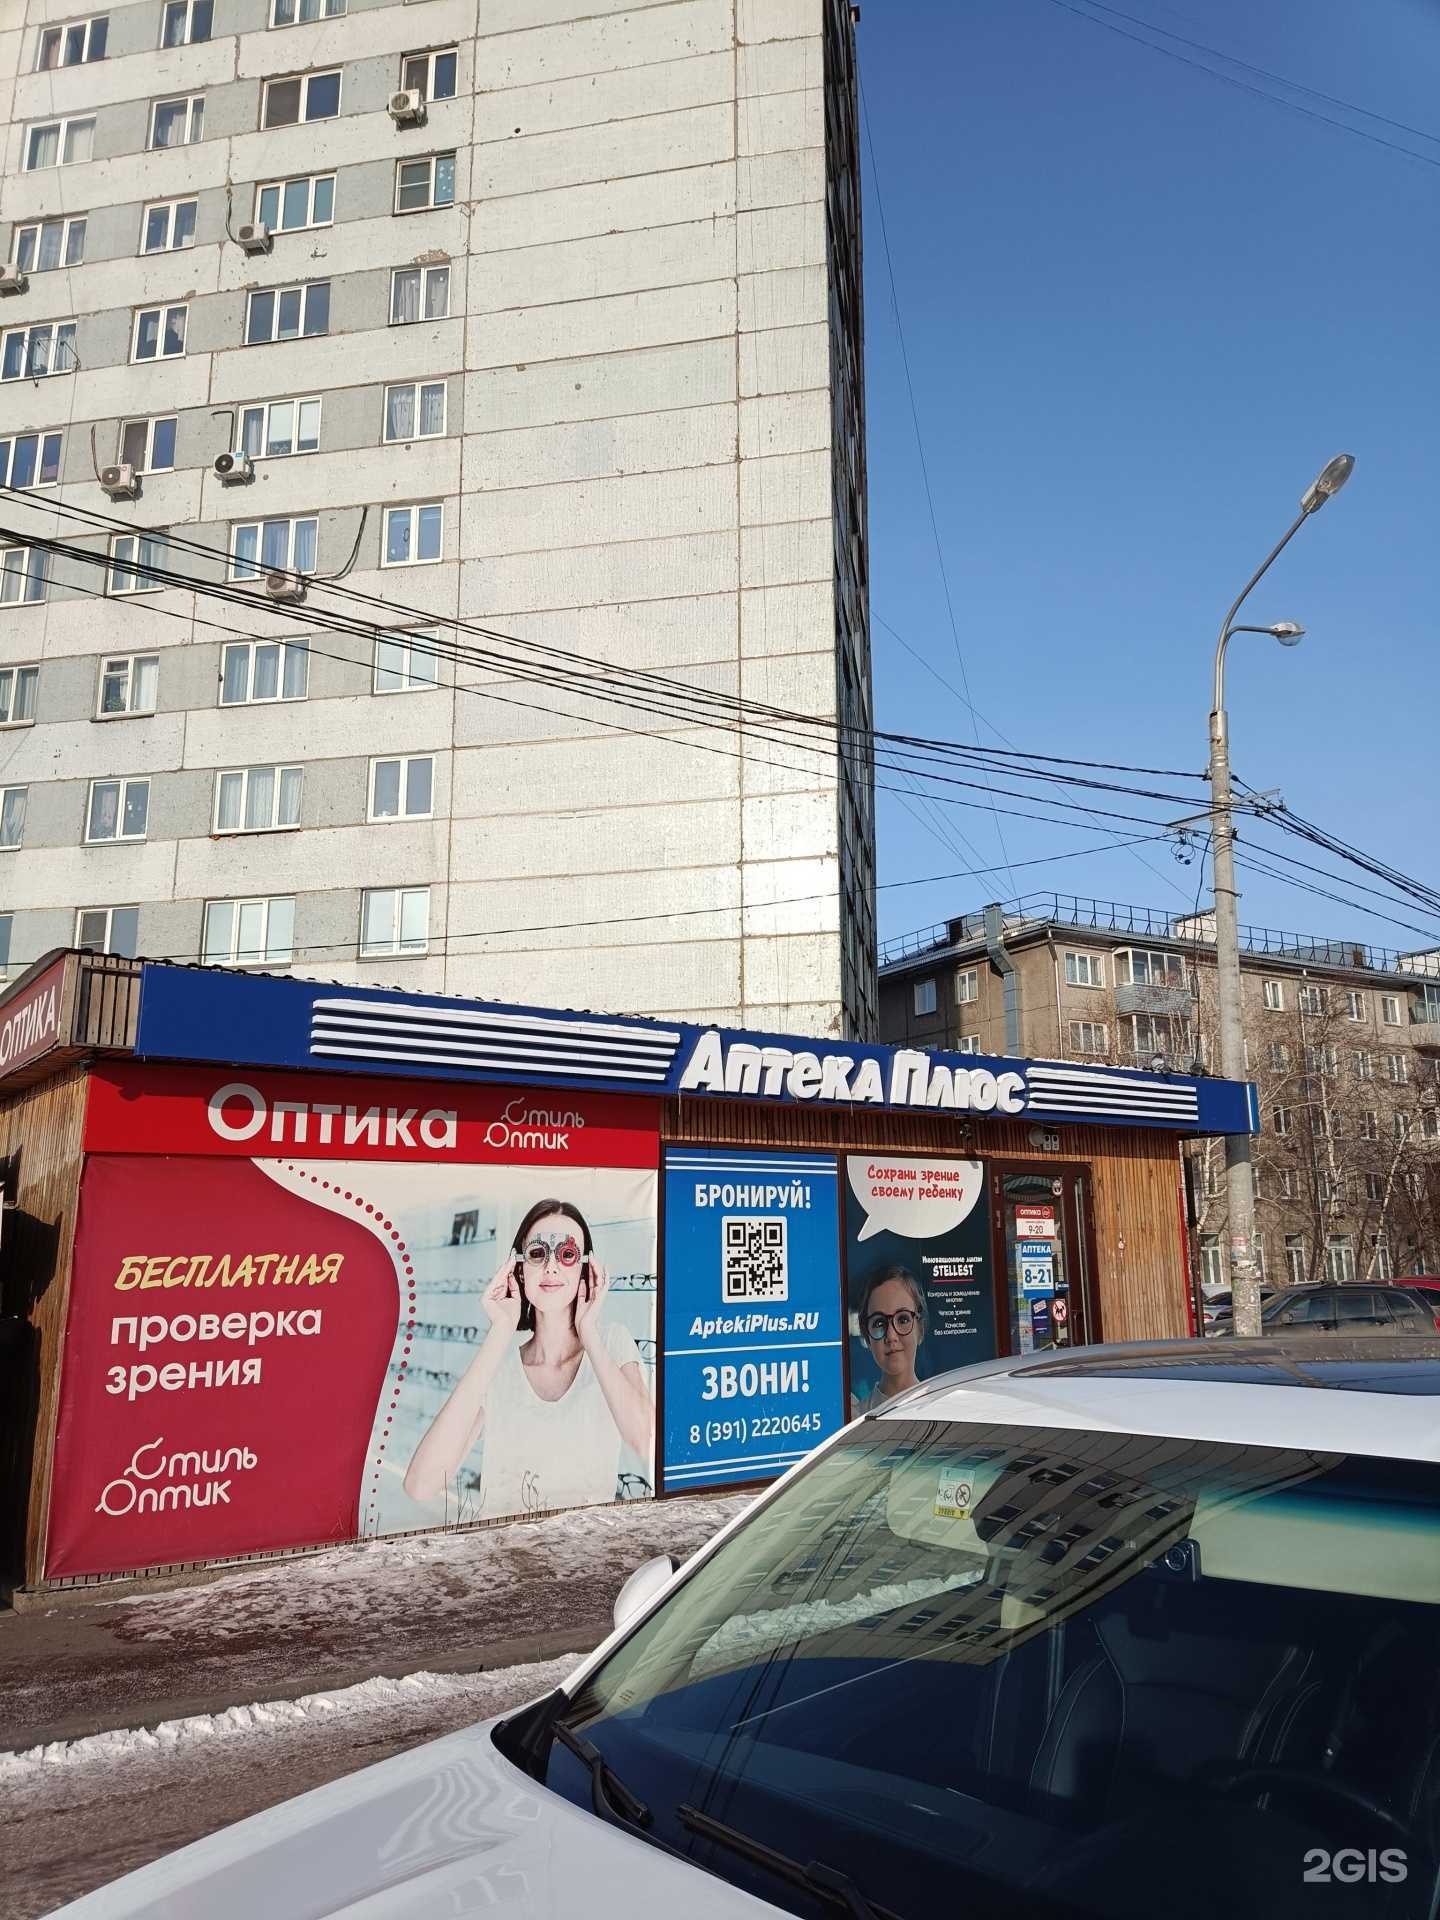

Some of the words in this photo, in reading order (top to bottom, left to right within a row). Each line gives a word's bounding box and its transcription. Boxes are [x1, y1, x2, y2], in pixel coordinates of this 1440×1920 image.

[0, 985, 56, 1066] ОПТИКА
[890, 1049, 1025, 1113] Плюс
[208, 1083, 458, 1149] Оптика
[868, 1165, 917, 1182] Сохрани
[921, 1170, 960, 1183] зрение
[694, 1179, 811, 1209] БРОНИРУЙ!
[872, 1186, 914, 1201] своему
[919, 1184, 964, 1201] ребенку
[1028, 1224, 1044, 1234] 9-20
[1022, 1245, 1052, 1254] АПТЕКА
[114, 1253, 345, 1291] БЕСПЛАТНАЯ
[932, 1264, 974, 1277] STELLEST
[1024, 1268, 1052, 1284] 8-21
[110, 1309, 323, 1351] проверка
[689, 1312, 820, 1339] AptekiPlus.RU
[105, 1358, 262, 1401] зрения
[701, 1360, 810, 1401] ЗВОНИ!
[690, 1424, 701, 1444] 8
[705, 1418, 747, 1447] (391)
[751, 1412, 821, 1438] 2220645
[95, 1479, 231, 1516] Оптик
